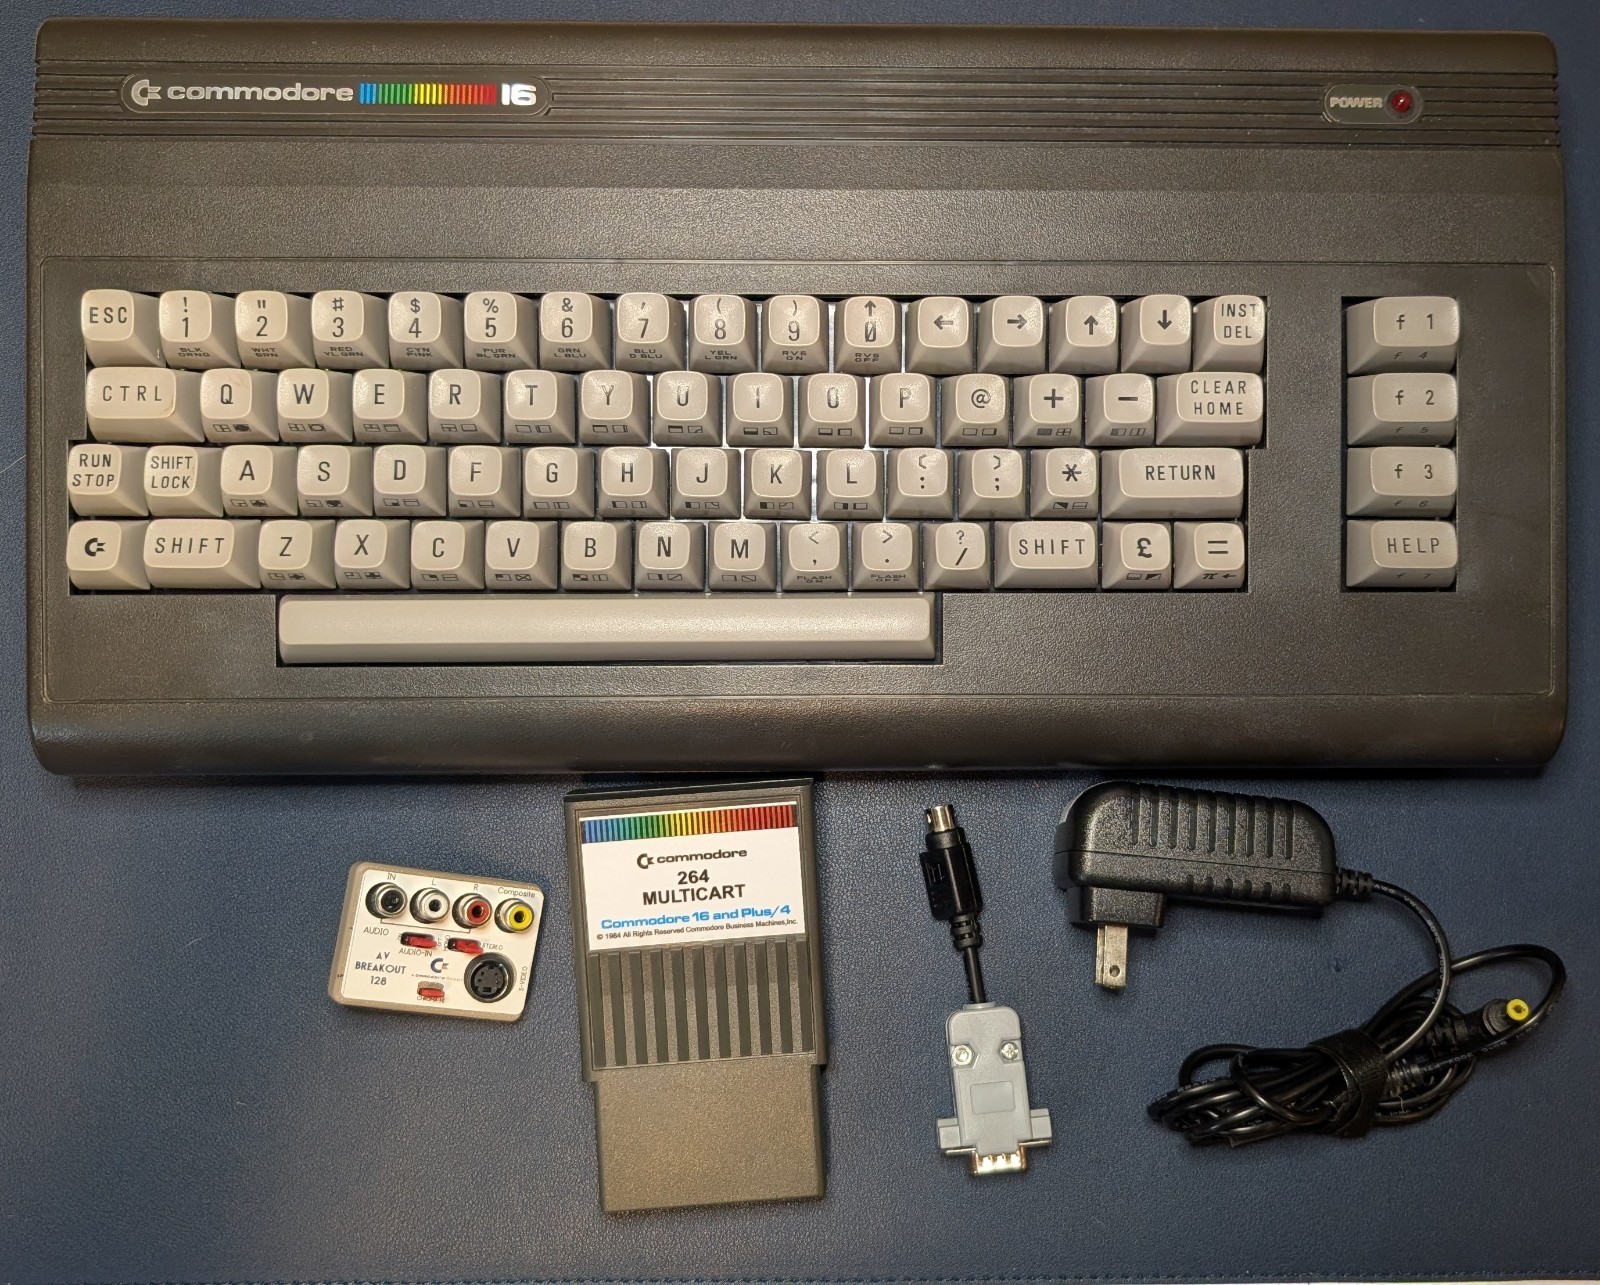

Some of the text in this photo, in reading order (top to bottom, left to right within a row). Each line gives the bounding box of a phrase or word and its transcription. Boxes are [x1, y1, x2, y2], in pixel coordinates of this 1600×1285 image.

[168, 83, 537, 106] commodore 16
[1329, 96, 1383, 109] POWER
[89, 307, 128, 323] ESC
[1221, 304, 1259, 317] INST
[182, 317, 189, 337] 1
[256, 316, 268, 337] 2
[332, 317, 344, 338] 3
[409, 318, 422, 338] 4
[485, 317, 497, 338] 5
[562, 318, 573, 338] 6
[638, 318, 649, 338] 7
[714, 319, 726, 339] 8
[788, 321, 800, 341] 9
[865, 321, 877, 342] 0
[1224, 326, 1252, 338] DEL
[102, 385, 163, 402] CTRL
[221, 384, 233, 404] Q
[294, 384, 315, 404] W
[374, 384, 385, 404] E
[449, 384, 462, 405] R
[524, 385, 538, 405] T
[601, 385, 614, 405] Y
[677, 385, 689, 406] U
[1190, 380, 1247, 394] CLEAR
[756, 387, 760, 408] I
[827, 387, 839, 409] O
[899, 387, 911, 408] P
[971, 388, 991, 408] @
[1043, 388, 1064, 408] +
[1194, 402, 1244, 415] HOME
[79, 454, 111, 467] RUN
[151, 456, 193, 469] SHIFT
[239, 460, 255, 481] A
[393, 460, 406, 481] D
[72, 474, 115, 487] STOP
[317, 461, 331, 481] S
[470, 462, 482, 482] F
[546, 463, 558, 483] G
[621, 463, 634, 482] H
[696, 463, 708, 483] J
[770, 464, 782, 484] K
[846, 463, 857, 484] L
[1145, 464, 1216, 481] RETURN
[151, 476, 190, 489] LOCK
[155, 538, 225, 554] SHIFT
[279, 537, 293, 557] Z
[353, 534, 369, 556] X
[432, 537, 445, 557] C
[506, 538, 520, 557] V
[584, 538, 596, 557] B
[657, 536, 671, 557] N
[956, 530, 965, 545] ?
[1019, 539, 1086, 555] SHIFT
[1137, 537, 1152, 558] £
[1387, 537, 1440, 553] HELP
[731, 539, 749, 558] M
[657, 848, 748, 864] commodore
[387, 873, 396, 881] IN
[473, 883, 479, 891] R
[677, 869, 710, 885] 264
[497, 887, 536, 899] Composite
[643, 884, 746, 906] MULTICART
[601, 904, 791, 929] Commodore 16 and Plus/4
[363, 926, 389, 936] AUDIO
[633, 930, 653, 938] Rights
[654, 927, 684, 935] Reserved
[686, 924, 724, 933] Commodore
[726, 922, 754, 930] Business
[375, 951, 390, 960] AV
[399, 948, 433, 957] AUDIO-IN
[355, 961, 407, 975] BREAKOUT
[370, 975, 387, 986] 128
[519, 966, 528, 992] S-VIDEO
